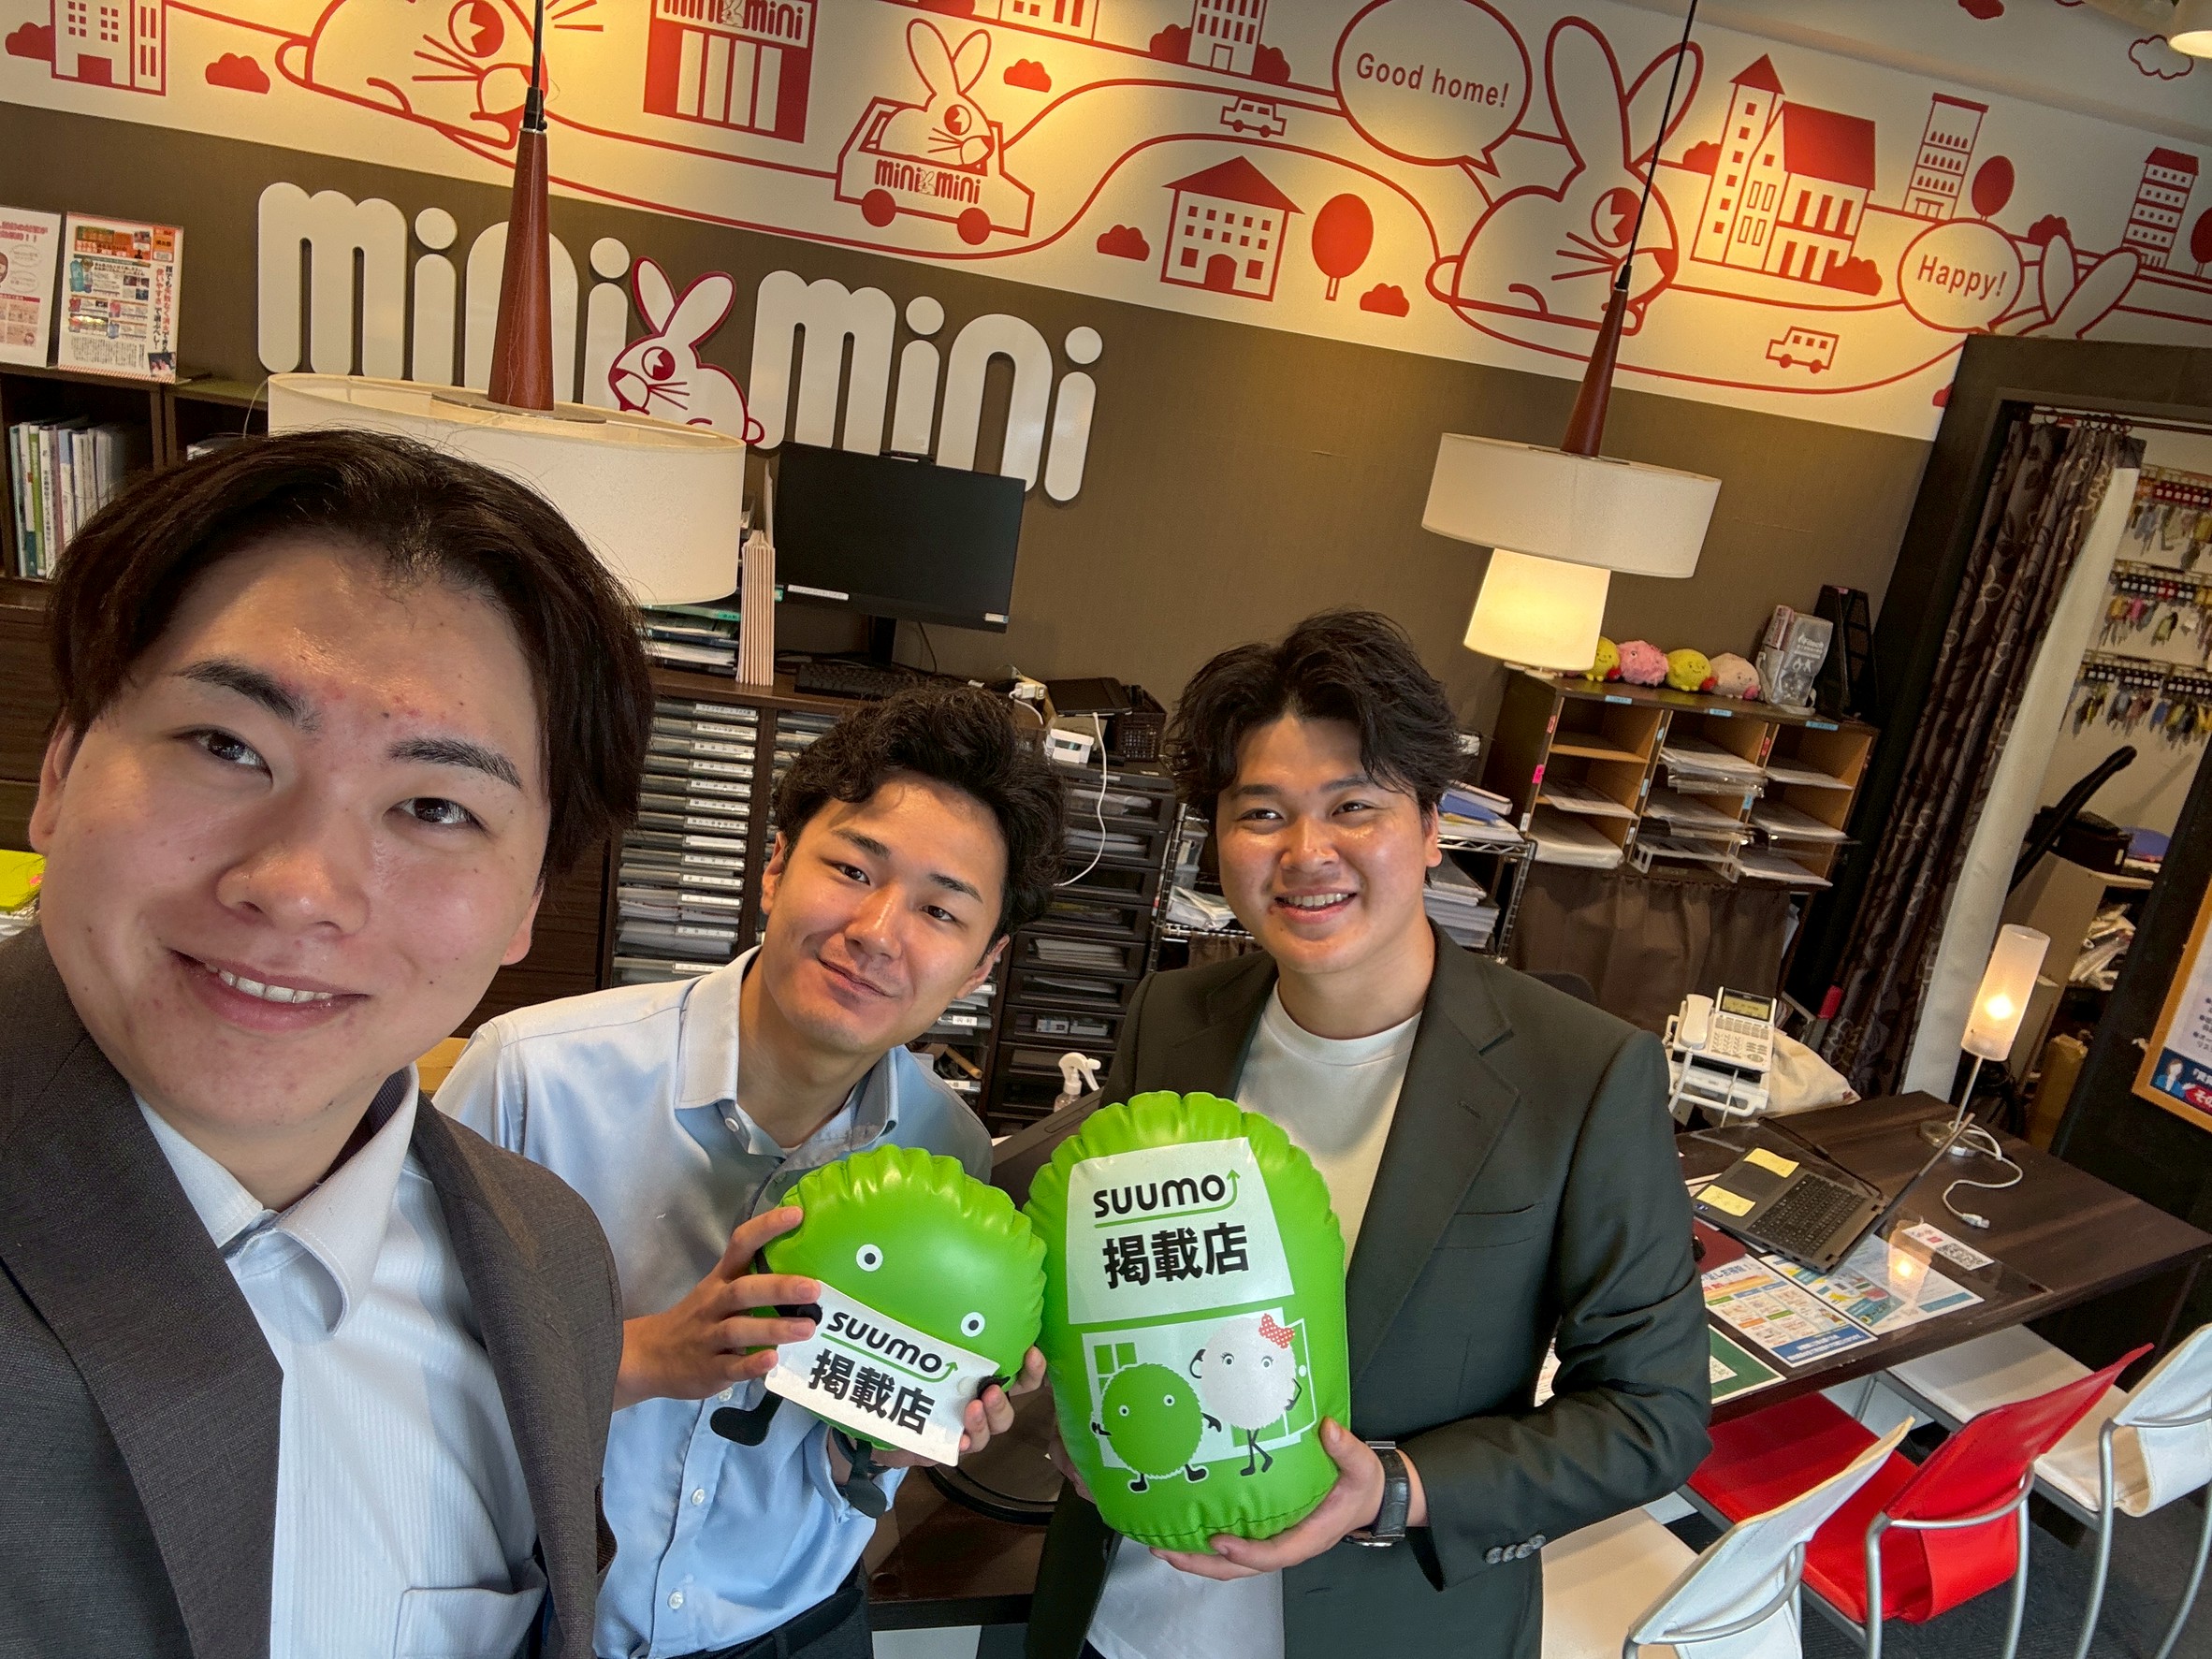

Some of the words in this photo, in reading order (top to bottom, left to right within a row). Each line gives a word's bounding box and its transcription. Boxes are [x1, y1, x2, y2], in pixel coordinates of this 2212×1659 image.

[743, 0, 804, 40] mini
[1357, 52, 1424, 90] Good
[1432, 68, 1509, 108] home!
[875, 159, 922, 193] mini
[935, 171, 981, 204] mini
[1917, 254, 2008, 300] Happy!
[257, 182, 631, 411] mini
[748, 269, 1103, 502] mini
[1102, 1221, 1250, 1290] 掲載店
[808, 1347, 936, 1435] 掲載店
